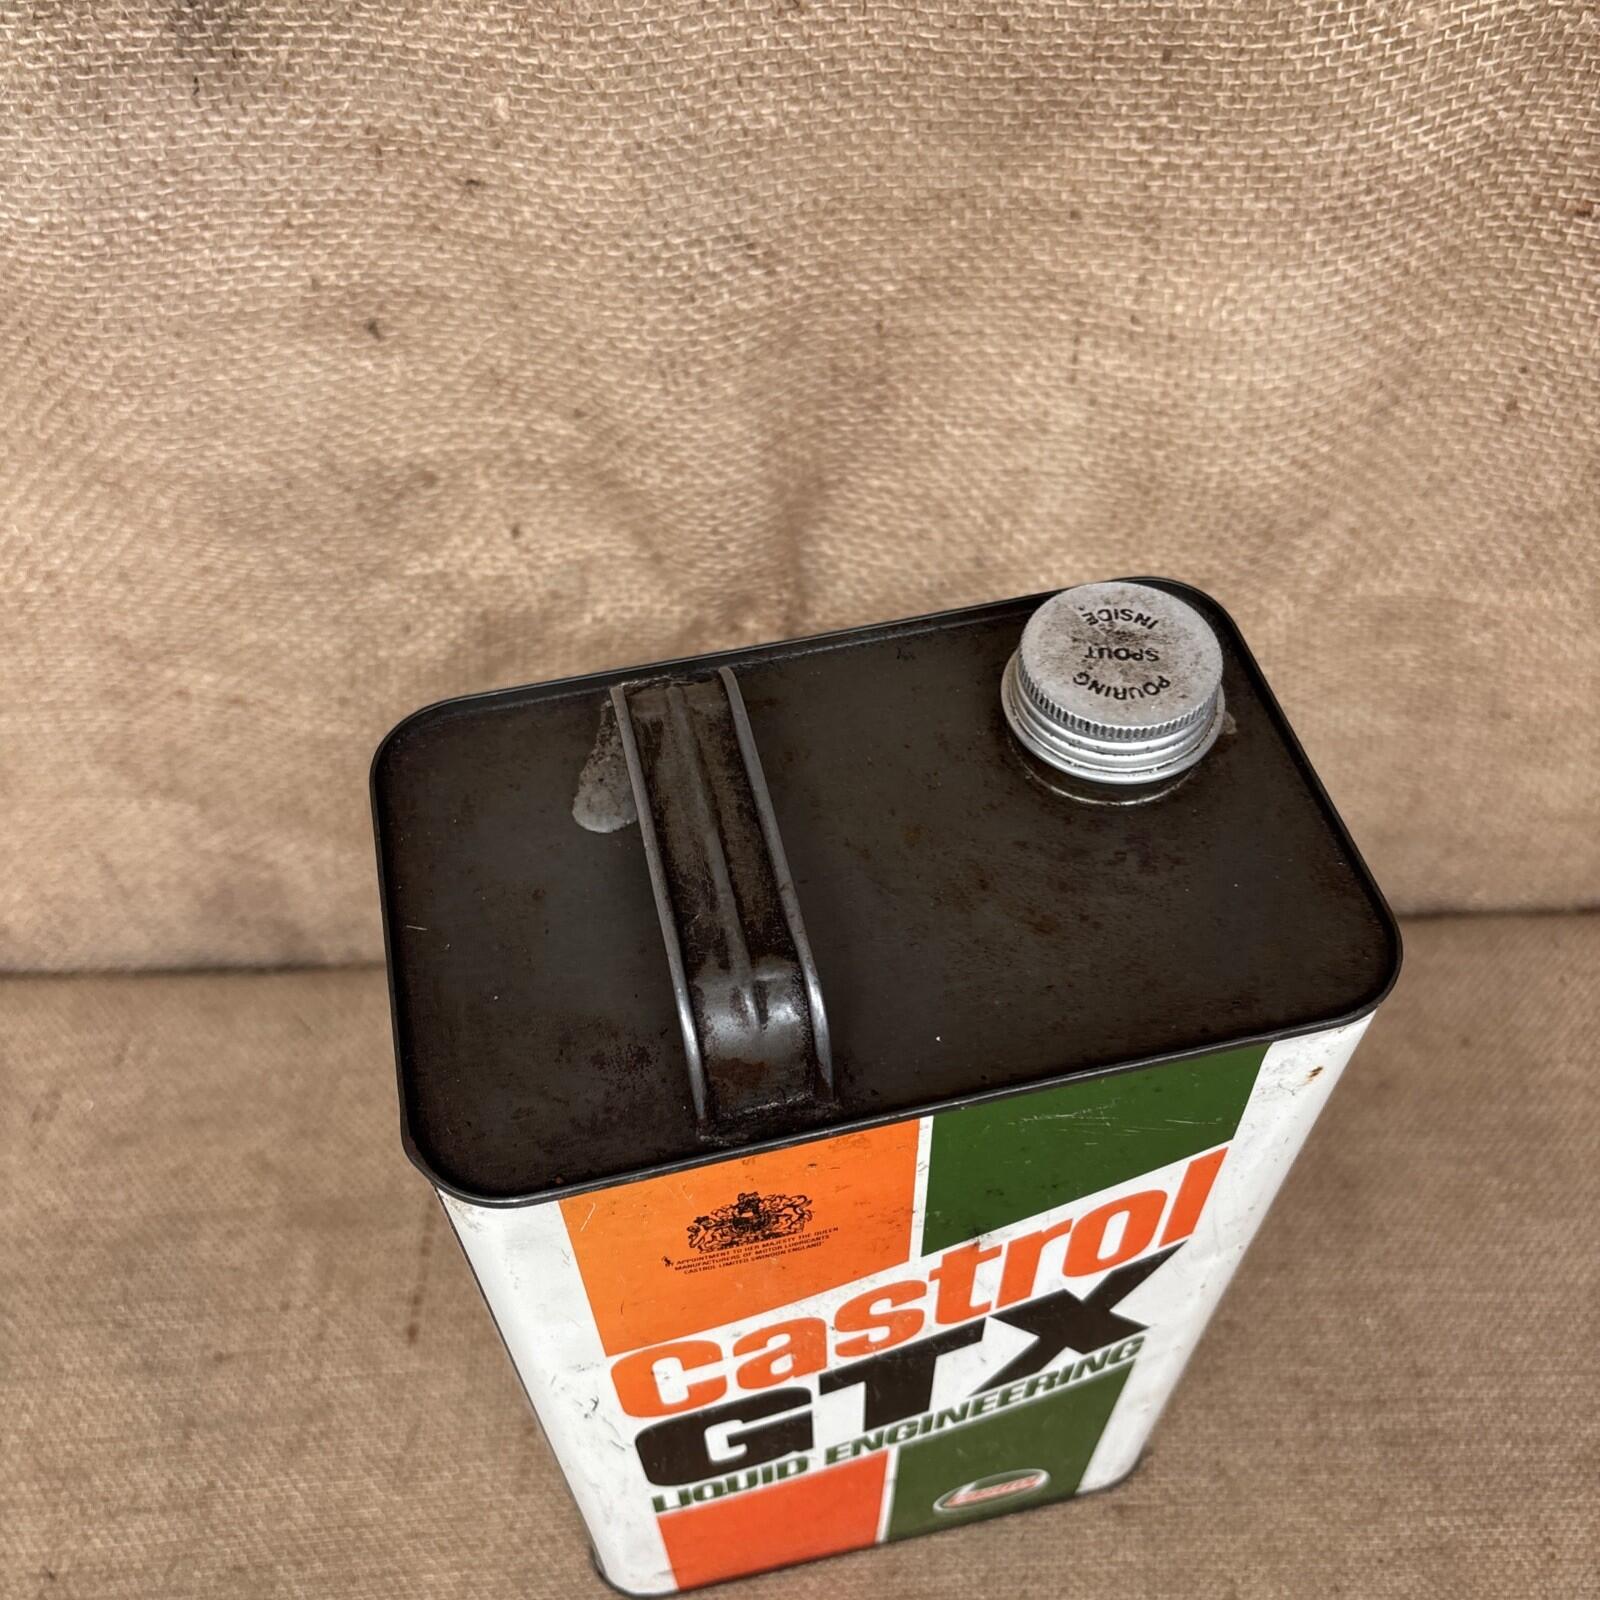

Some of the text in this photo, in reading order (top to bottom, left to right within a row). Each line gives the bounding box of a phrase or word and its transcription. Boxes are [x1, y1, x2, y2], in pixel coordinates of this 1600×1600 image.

[1082, 608, 1158, 629] INSIDE
[1086, 646, 1160, 662] SPOUT
[1073, 671, 1171, 700] POURING
[675, 1254, 740, 1271] MANUFACTURERS
[755, 1246, 783, 1255] MOTOR
[785, 1235, 830, 1248] LUBRICANTS
[677, 1251, 730, 1265] APPOINTMENT
[762, 1237, 796, 1247] MAJESTY
[814, 1227, 839, 1236] QUEEN
[719, 1258, 749, 1268] LIMITED
[752, 1250, 786, 1262] SWINDON
[635, 1239, 1188, 1487] GTX
[652, 1336, 1145, 1513] LIQUID ENGINEERING
